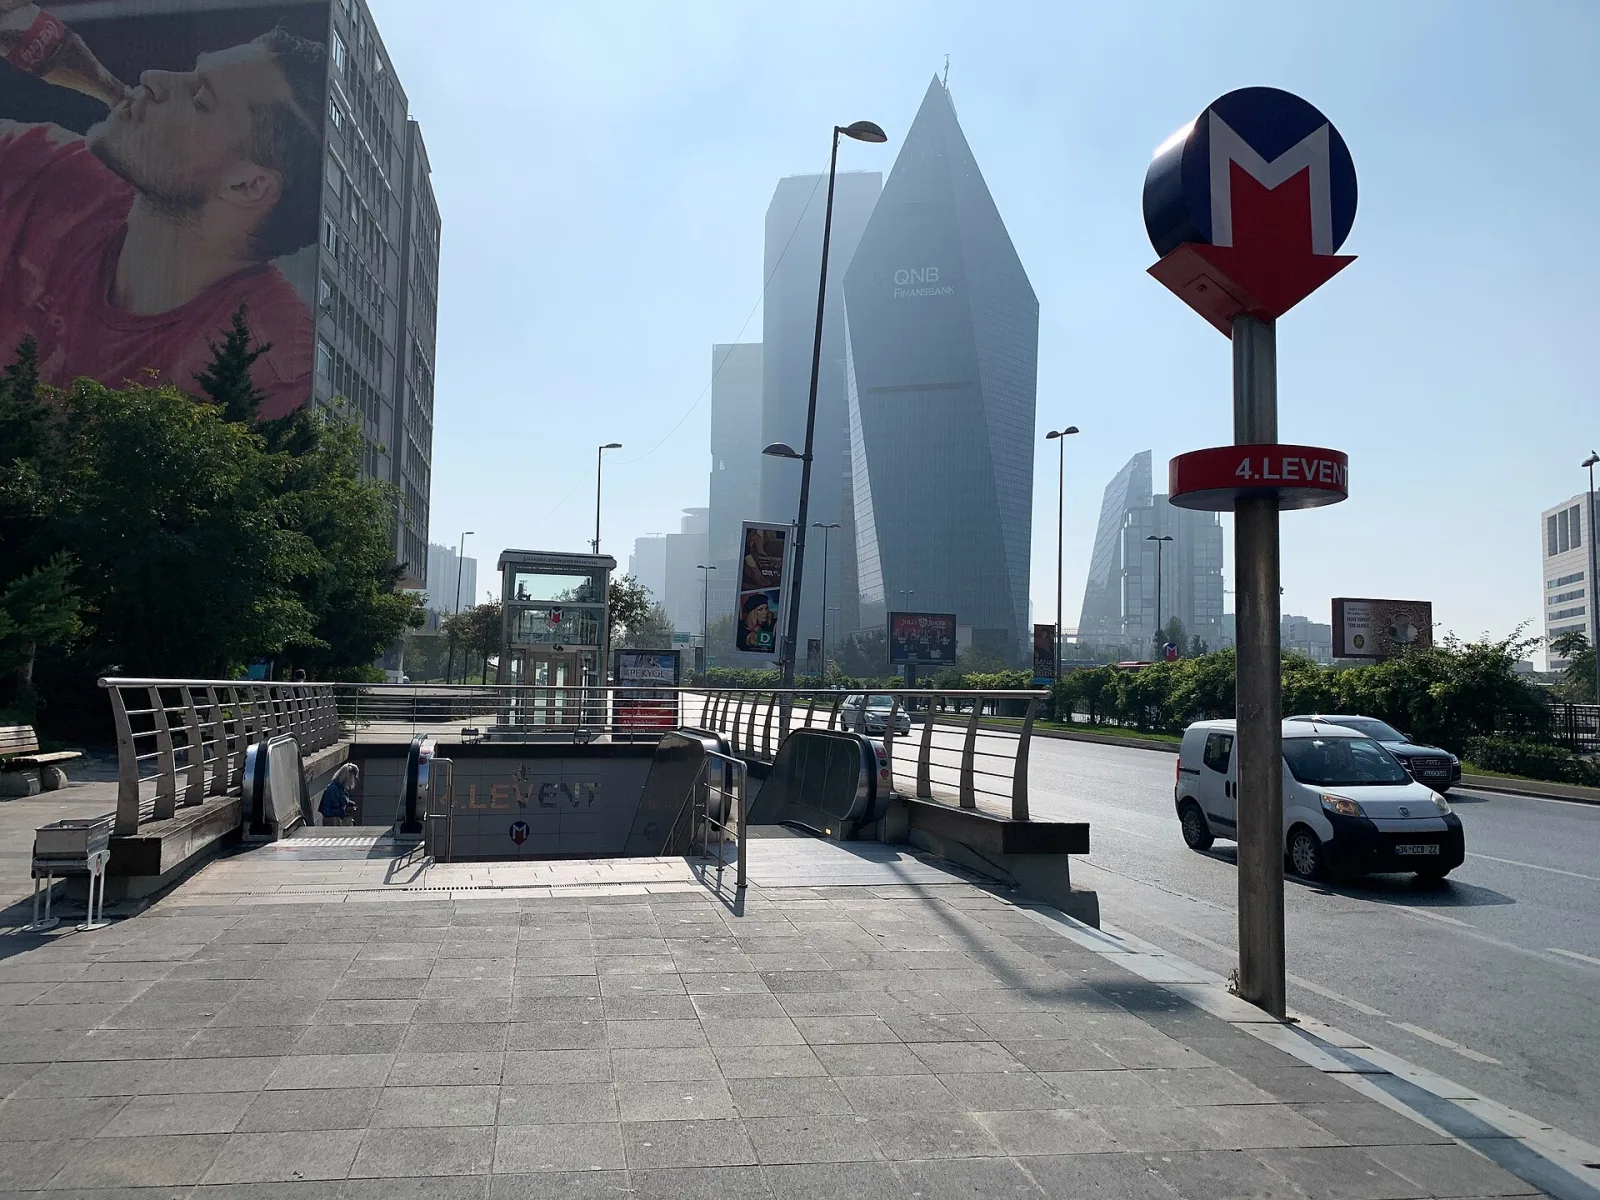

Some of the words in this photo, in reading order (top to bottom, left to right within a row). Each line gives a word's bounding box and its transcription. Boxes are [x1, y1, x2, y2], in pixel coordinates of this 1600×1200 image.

[1209, 107, 1333, 256] M
[893, 267, 940, 285] QNB
[1235, 457, 1348, 487] 4.LEVENT
